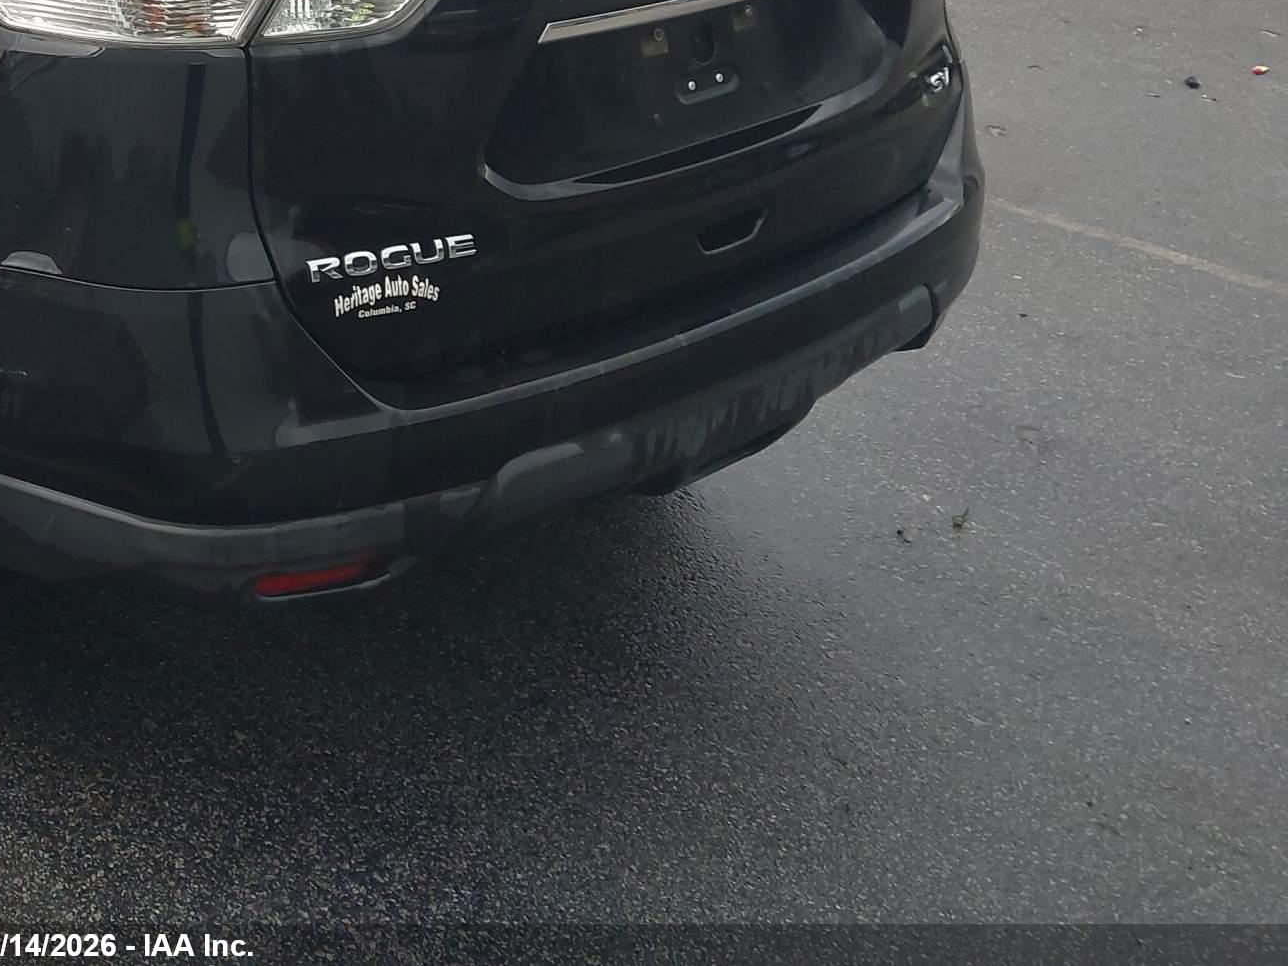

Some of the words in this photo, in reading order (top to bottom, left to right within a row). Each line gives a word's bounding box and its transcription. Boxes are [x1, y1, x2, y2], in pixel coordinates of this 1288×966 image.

[305, 233, 478, 283] ROGUE
[334, 283, 383, 318] Heritage
[384, 274, 410, 298] Auto
[411, 275, 440, 302] Sales
[358, 304, 403, 318] Columbia,
[404, 300, 417, 311] SC
